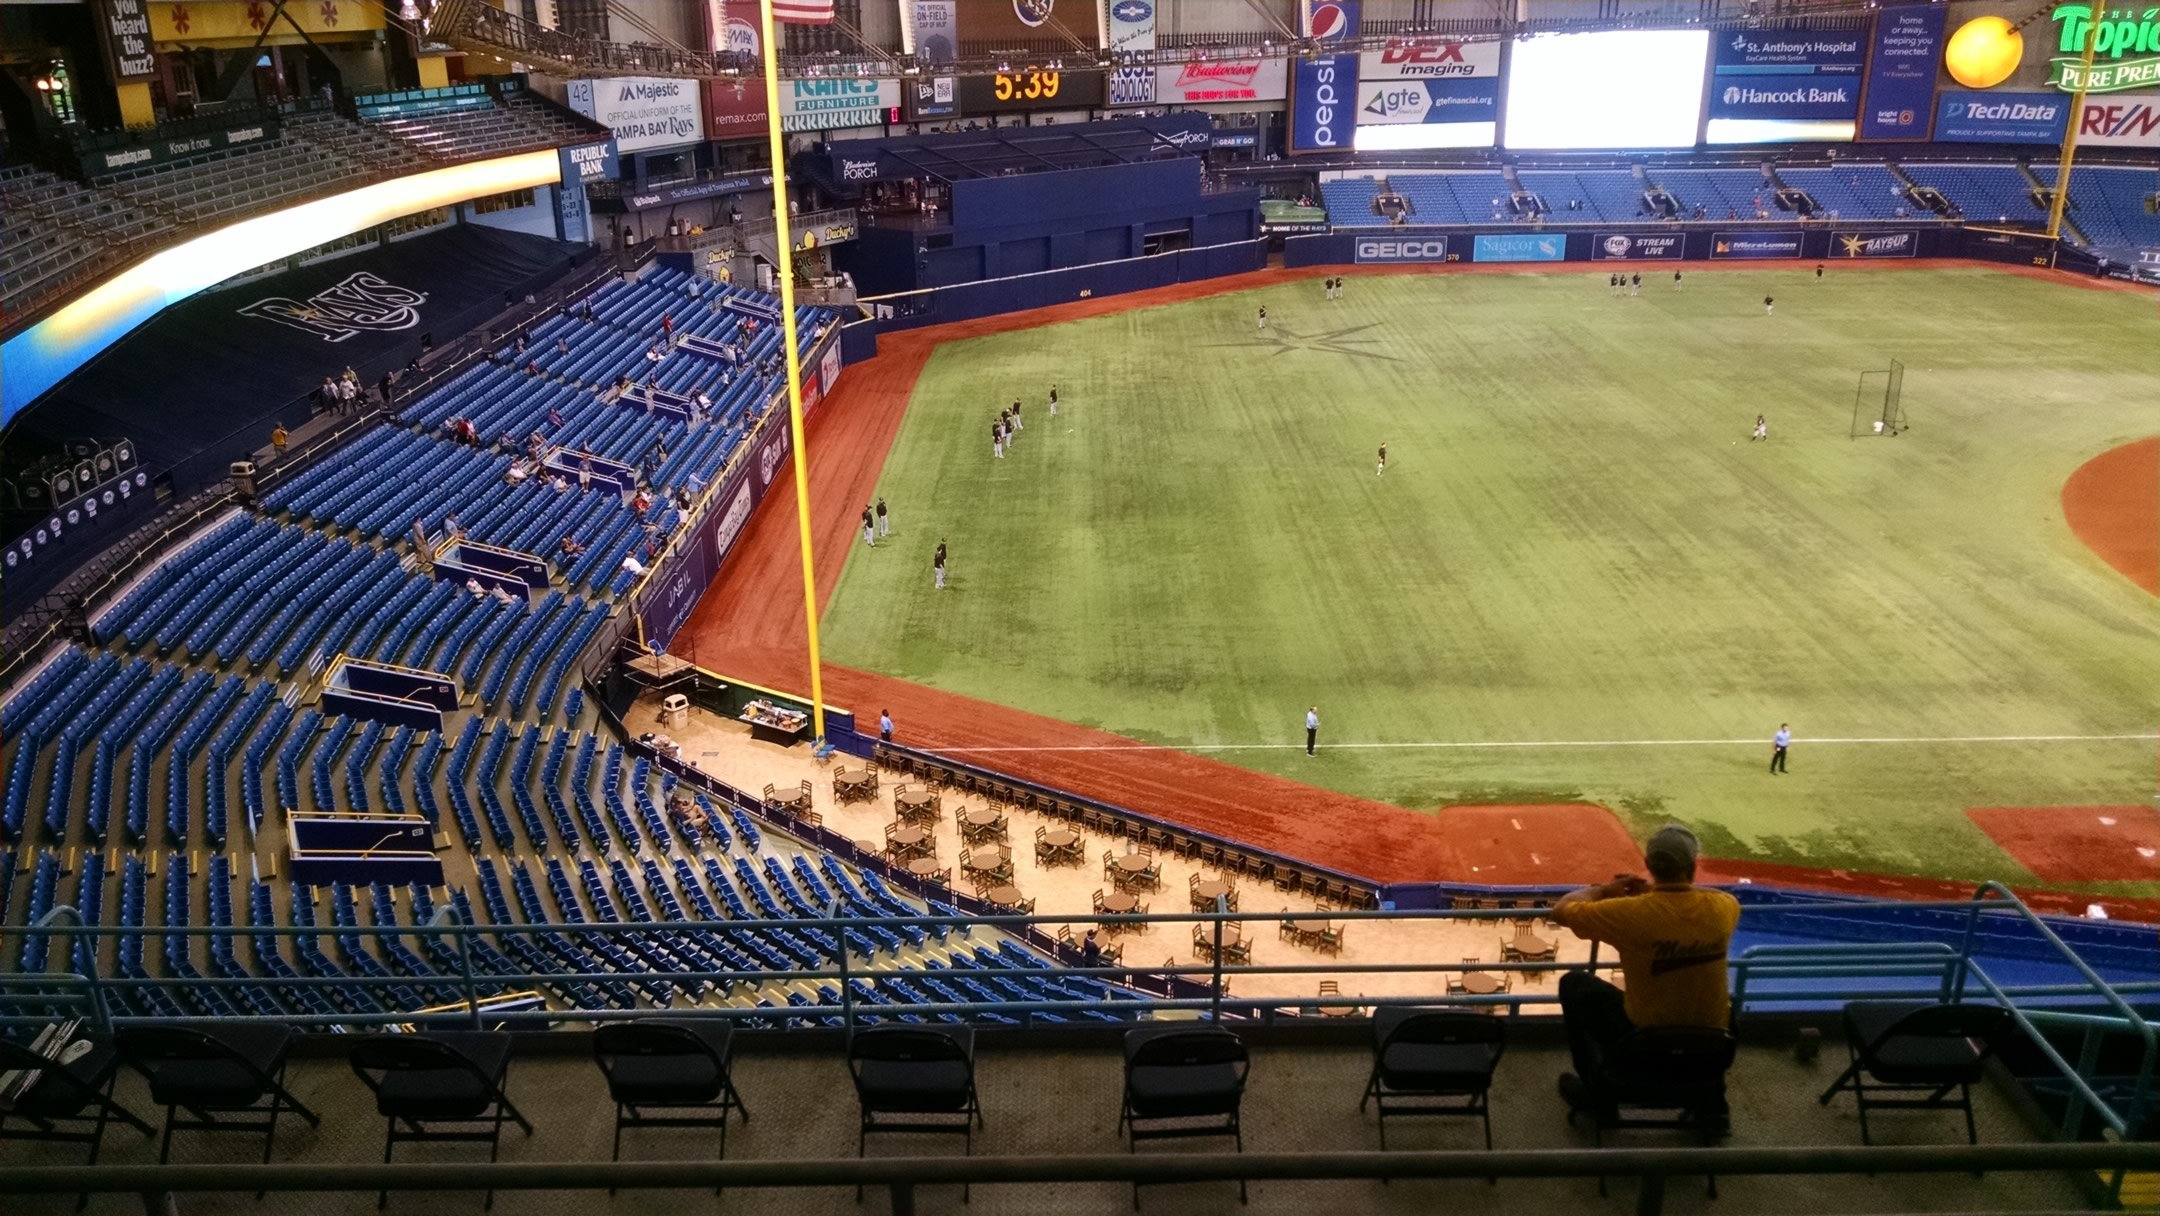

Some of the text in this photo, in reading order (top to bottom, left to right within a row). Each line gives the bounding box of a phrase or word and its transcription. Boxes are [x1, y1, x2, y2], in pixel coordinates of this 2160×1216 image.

[114, 0, 138, 19] you
[917, 12, 948, 21] ON-FIELD
[111, 14, 148, 36] heard
[1899, 16, 1923, 25] home
[123, 35, 145, 55] the
[1747, 41, 1857, 55] St. Anthony's Hospital
[1884, 36, 1933, 47] keeping you
[1381, 38, 1464, 64] DEX
[1884, 47, 1929, 56] connected.
[119, 54, 154, 76] buzz?
[1400, 63, 1475, 76] imaging
[994, 66, 1059, 100] 5:39
[2061, 66, 2112, 87] PURE
[573, 84, 589, 102] 42
[636, 82, 680, 102] Majestic
[937, 90, 951, 98] ERA
[1110, 78, 1154, 102] RADIOLOGY
[1741, 88, 1847, 104] Hancock Bank
[799, 96, 876, 110] FURNITURE
[1315, 59, 1338, 146] pepsi
[1387, 89, 1420, 111] gte
[1435, 96, 1492, 107] gtefinancial.org
[608, 104, 693, 123] OFFICIAL UNIFORM OF THE
[715, 111, 767, 125] remax.com
[1967, 103, 2056, 120] Tech Data
[611, 124, 647, 139] TAMPA
[649, 121, 668, 136] BAY
[1183, 133, 1208, 143] PORCH
[169, 141, 190, 155] Know
[570, 144, 610, 163] REPUBLIC
[580, 159, 604, 176] BANK
[843, 167, 877, 180] PORCH
[825, 223, 855, 241] Ducky's
[1359, 242, 1443, 258] GEICO
[1483, 238, 1535, 254] Sagicor
[1636, 239, 1675, 247] STREAM
[1645, 246, 1664, 255] LIVE
[708, 246, 735, 264] Ducky's
[1080, 289, 1092, 297] 404
[668, 570, 691, 608] JABIL
